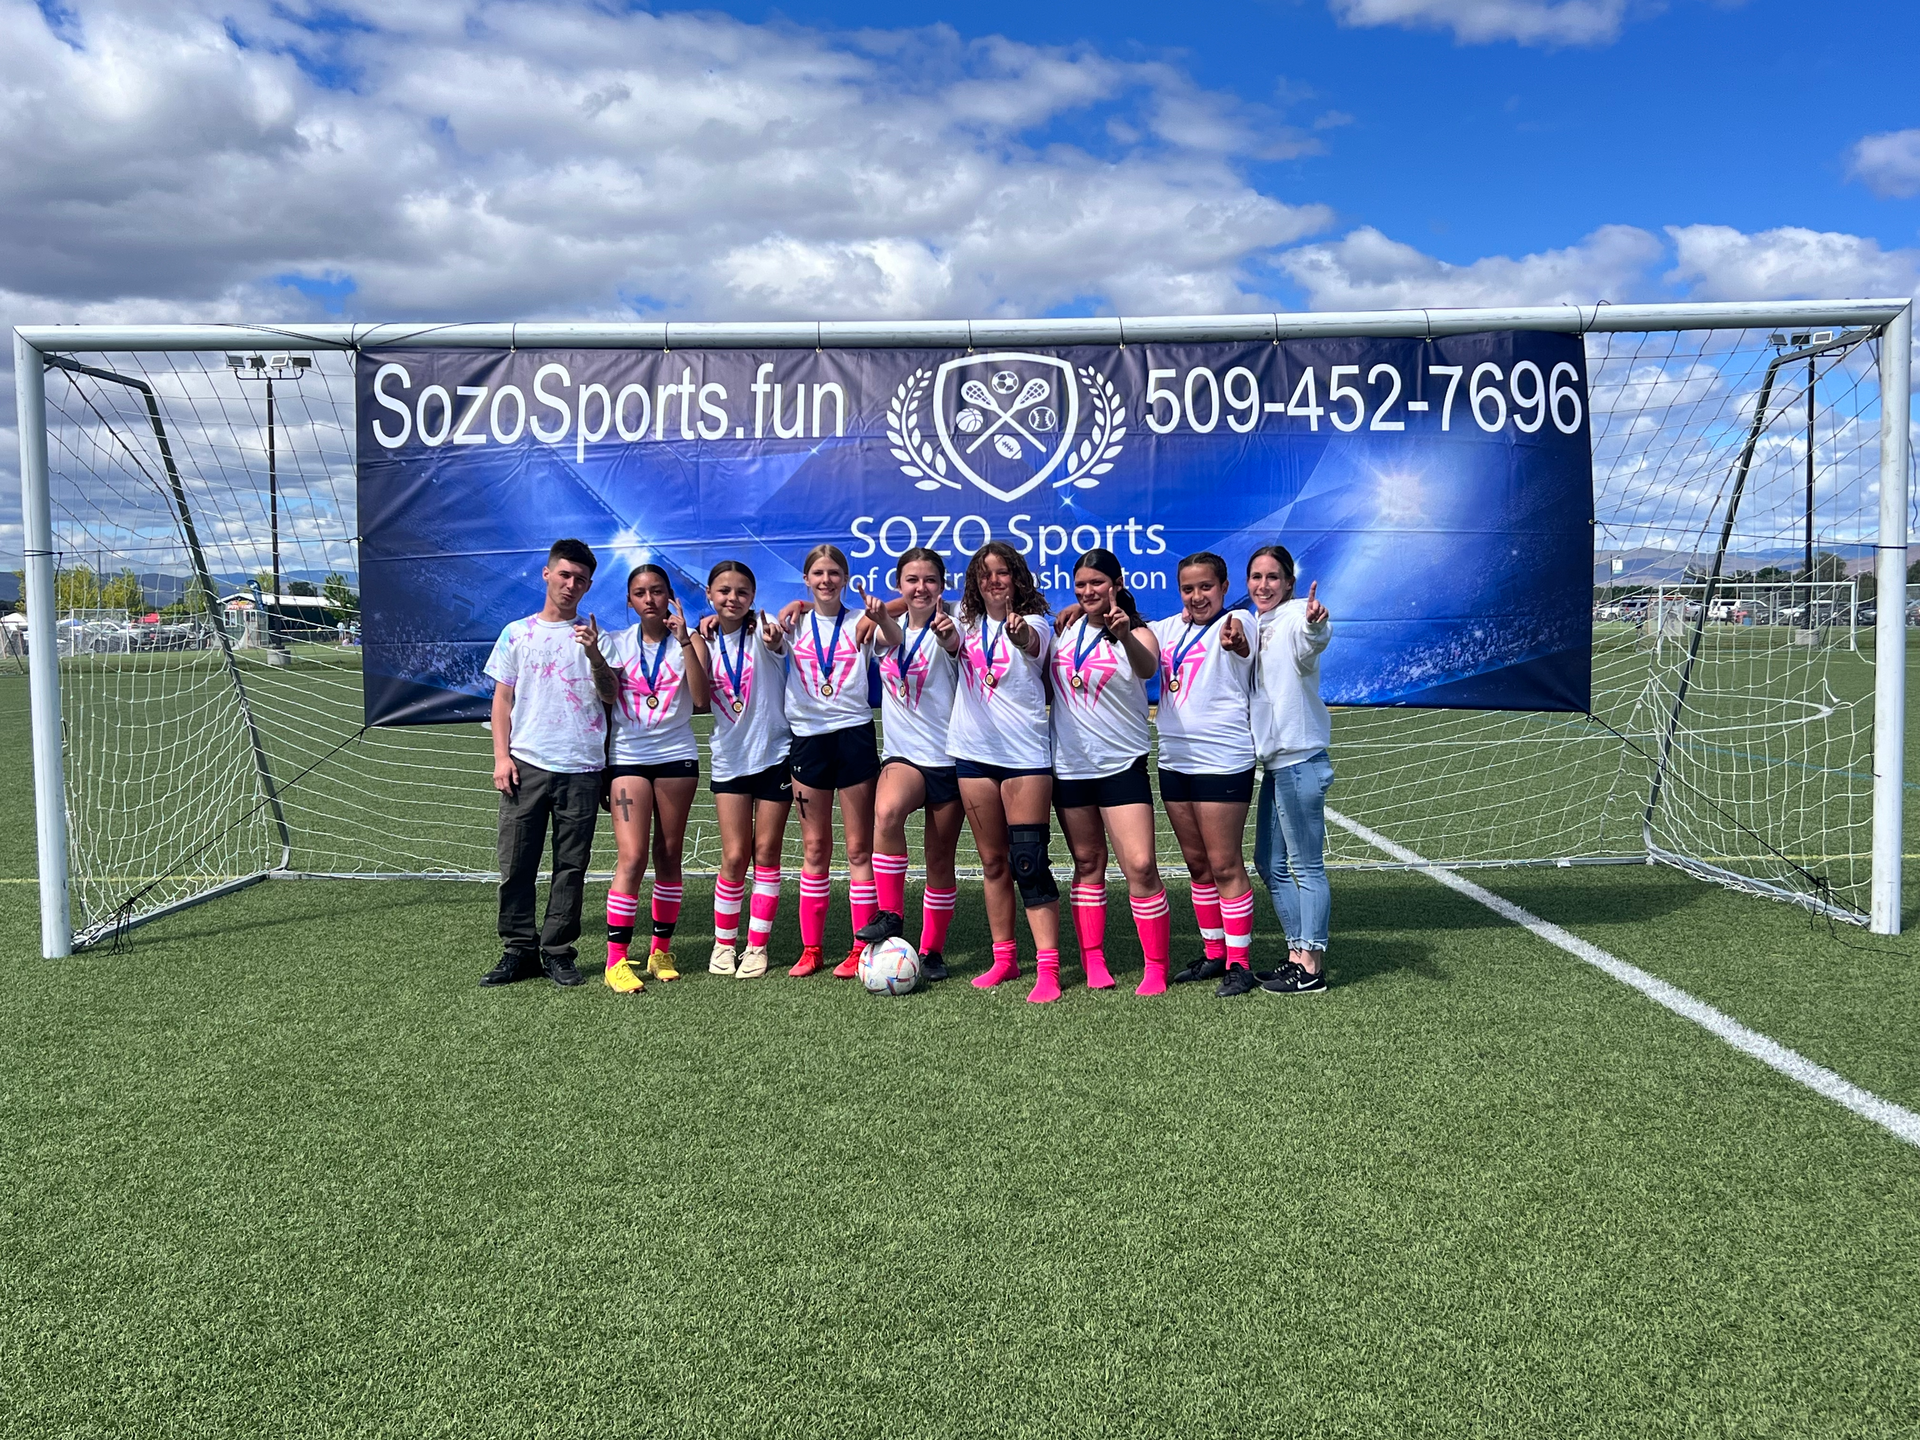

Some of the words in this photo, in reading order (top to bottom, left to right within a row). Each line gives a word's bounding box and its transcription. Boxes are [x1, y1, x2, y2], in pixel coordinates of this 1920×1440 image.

[371, 362, 845, 464] SozoSports.fun
[1145, 359, 1583, 435] 509-452-7696
[850, 515, 991, 558] SOZO
[1008, 514, 1167, 565] Sports
[848, 566, 880, 593] of
